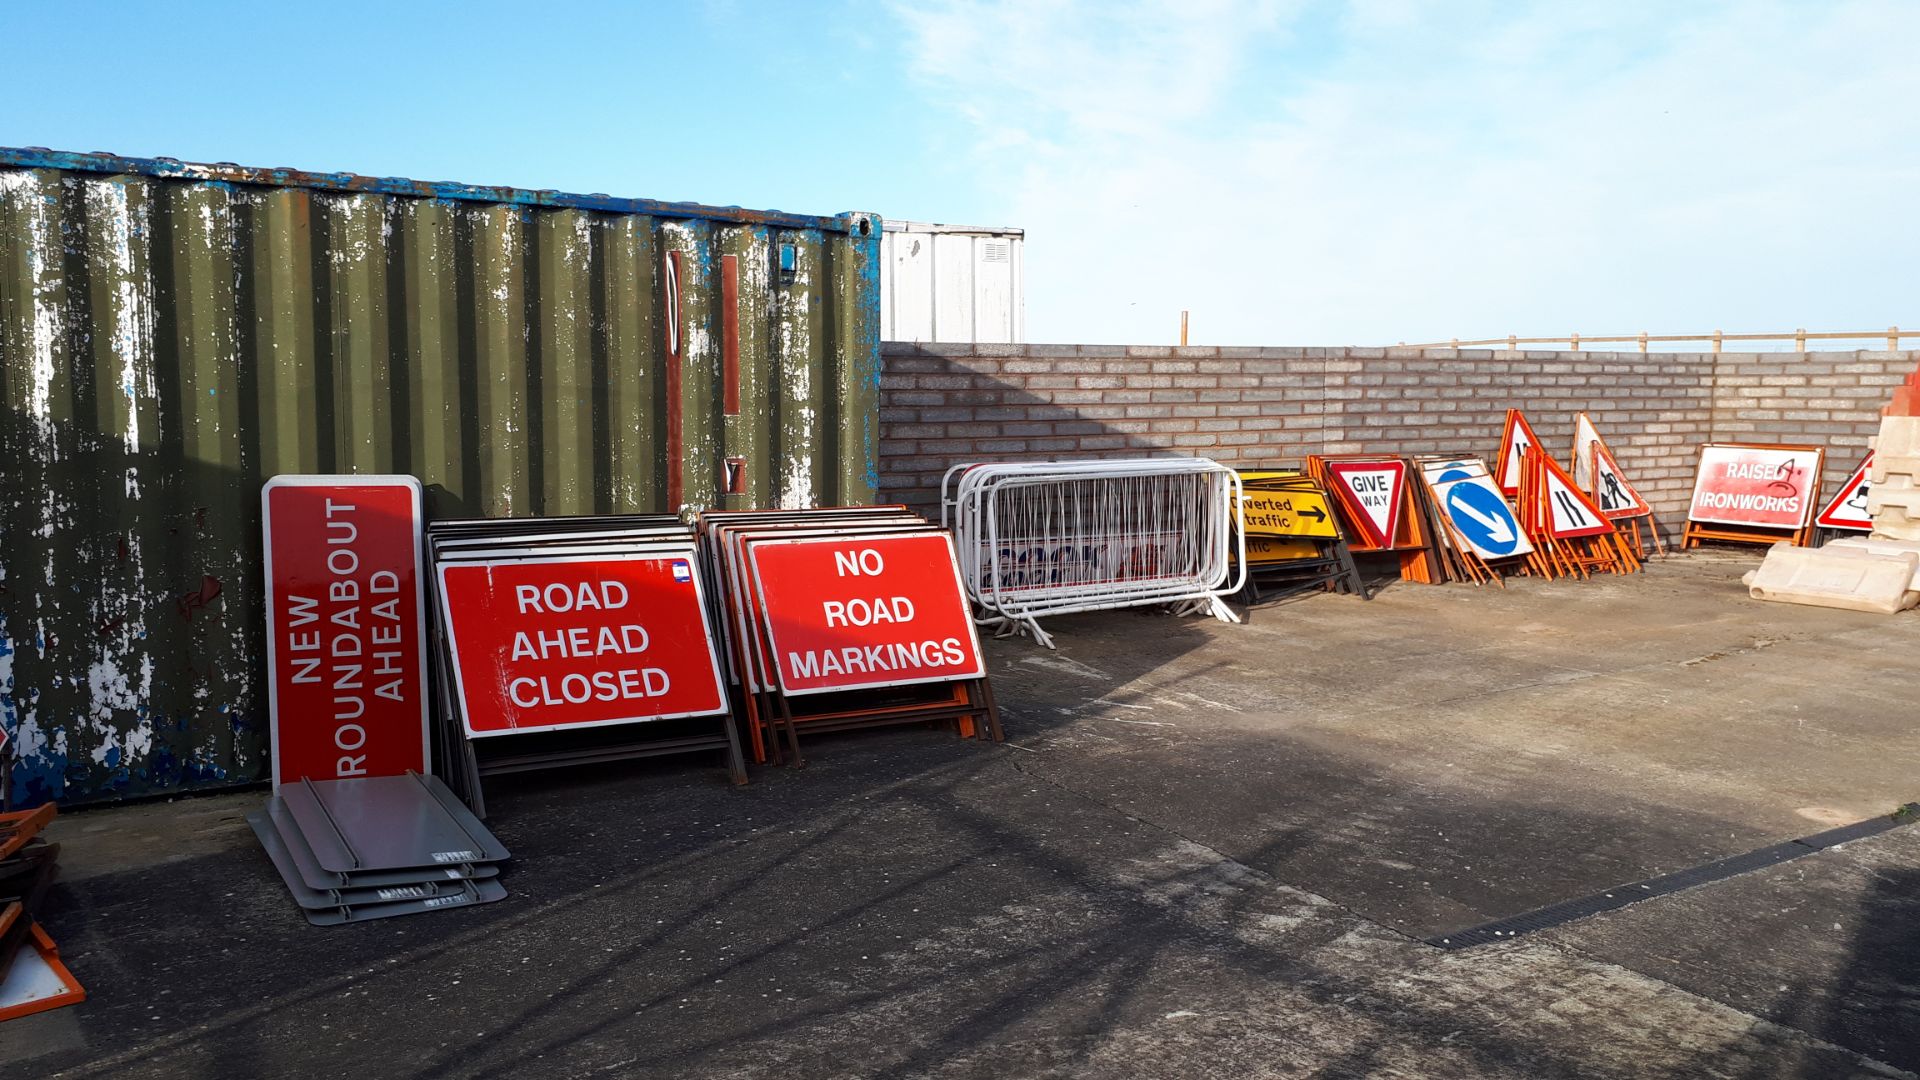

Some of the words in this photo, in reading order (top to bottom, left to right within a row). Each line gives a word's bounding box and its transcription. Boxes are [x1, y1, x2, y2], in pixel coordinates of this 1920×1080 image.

[1352, 475, 1389, 493] GIVE
[1725, 462, 1788, 481] RAISED
[1361, 494, 1388, 507] WAY
[1699, 491, 1801, 513] IRONWORKS
[1244, 513, 1291, 528] traffic
[834, 549, 884, 577] NO
[515, 580, 629, 614] ROAD
[823, 596, 915, 628] ROAD
[287, 595, 322, 684] NEW
[325, 498, 367, 777] ROUNDABOUT
[369, 570, 404, 702] AHEAD
[511, 624, 650, 662] AHEAD
[788, 637, 965, 679] MARKINGS
[509, 667, 671, 708] CLOSED
